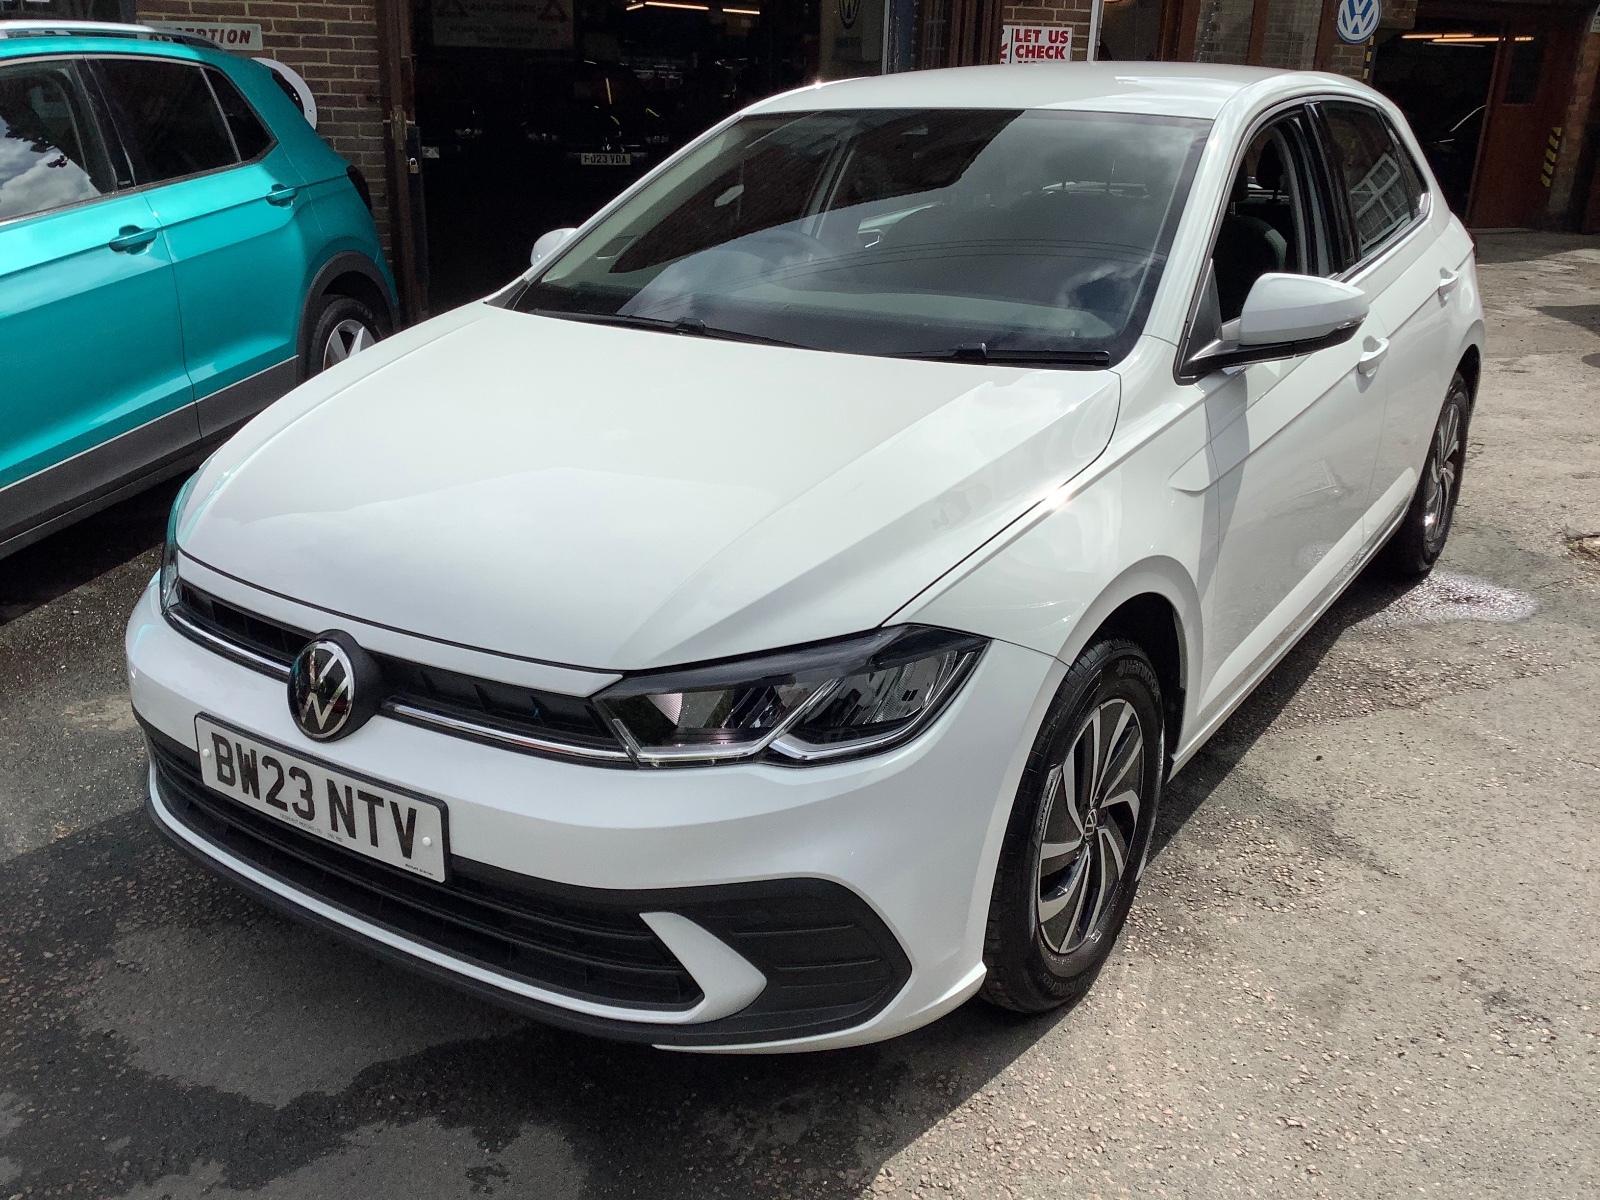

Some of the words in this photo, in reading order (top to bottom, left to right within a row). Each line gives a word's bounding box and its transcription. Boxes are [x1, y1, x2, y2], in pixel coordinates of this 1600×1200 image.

[1014, 28, 1042, 43] LET
[1047, 29, 1069, 44] US
[1014, 44, 1066, 60] CHECK
[211, 731, 316, 822] BW23
[326, 778, 418, 860] NTV
